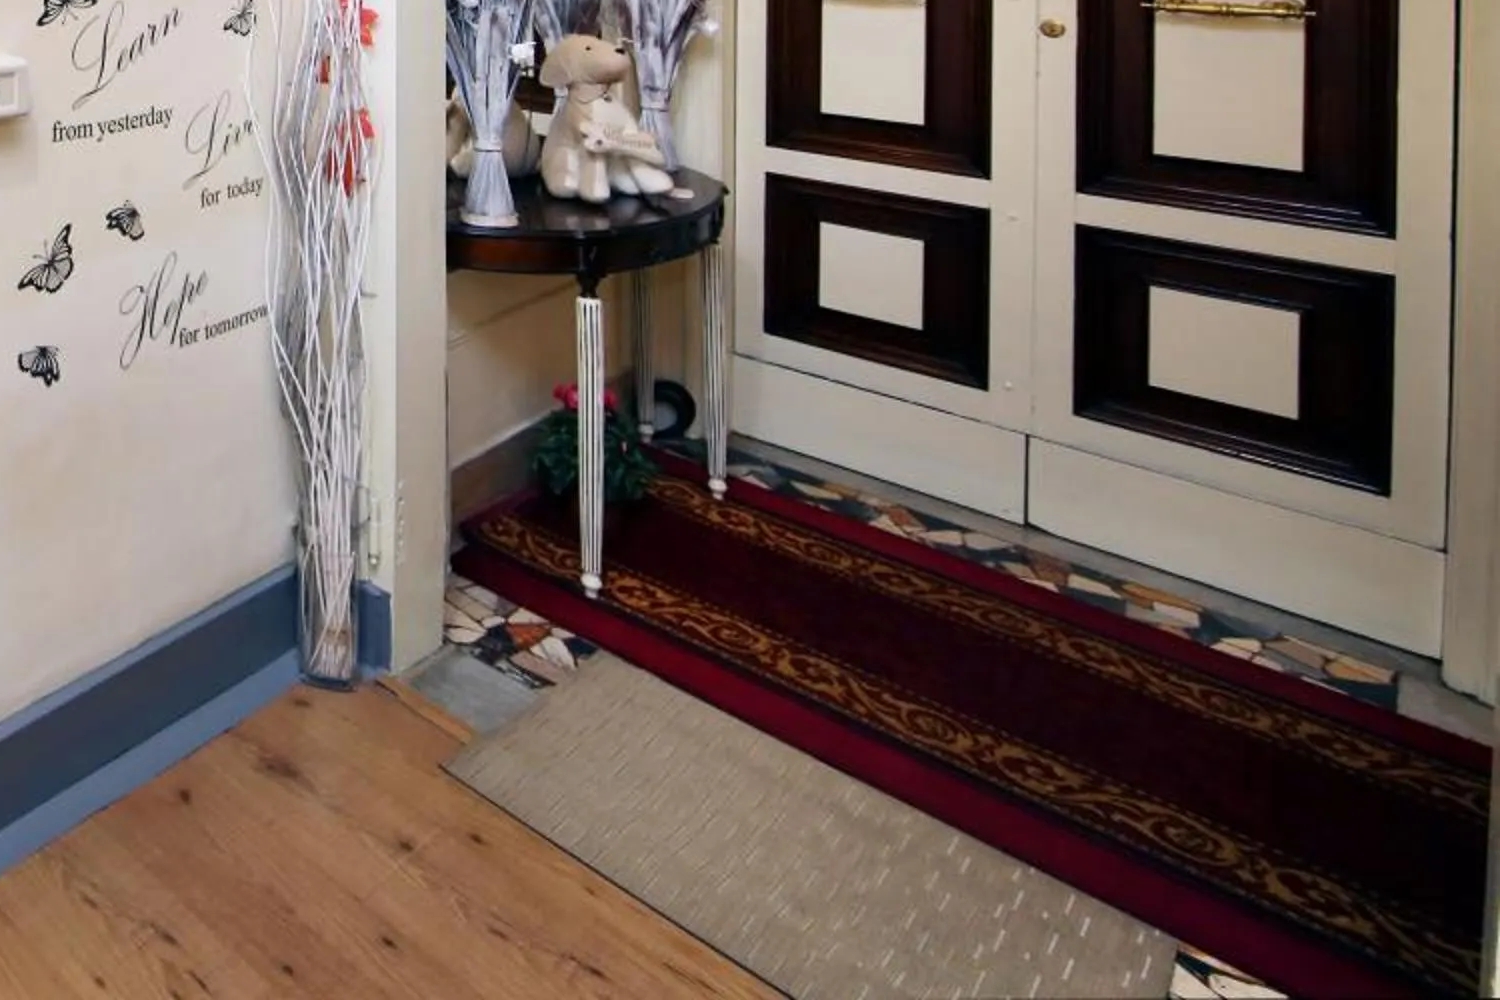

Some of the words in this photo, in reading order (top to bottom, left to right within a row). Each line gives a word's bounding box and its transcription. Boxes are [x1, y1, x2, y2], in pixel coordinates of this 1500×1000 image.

[71, 0, 183, 112] Learn
[51, 119, 94, 143] from
[96, 105, 173, 143] yesterday
[200, 187, 221, 209] for
[227, 176, 264, 198] today
[118, 251, 209, 371] Hope
[179, 327, 201, 348] for
[203, 304, 268, 341] tomorrow
